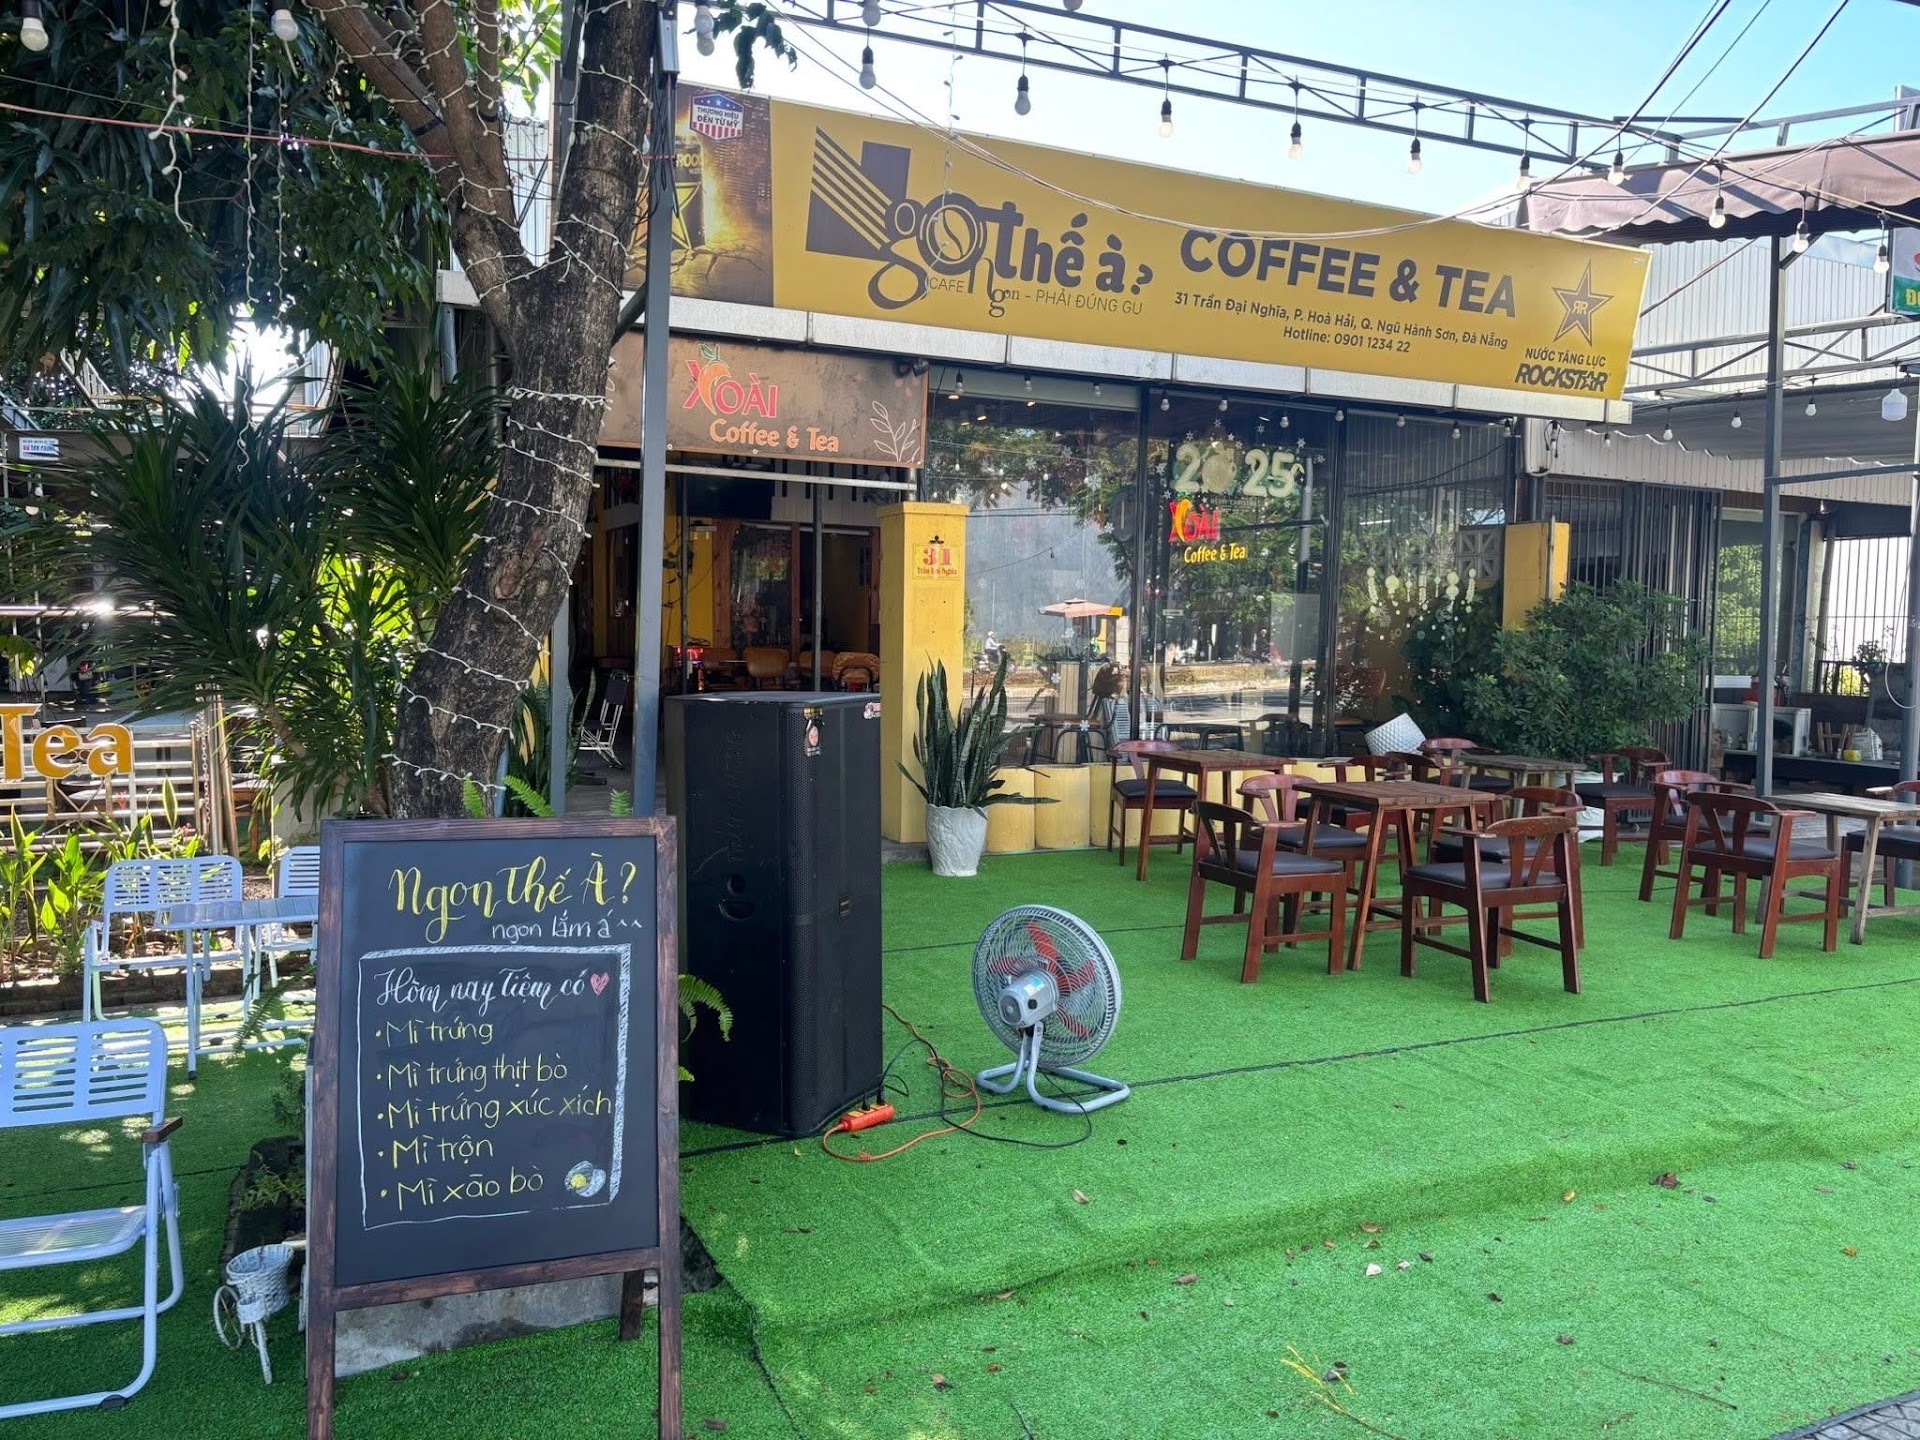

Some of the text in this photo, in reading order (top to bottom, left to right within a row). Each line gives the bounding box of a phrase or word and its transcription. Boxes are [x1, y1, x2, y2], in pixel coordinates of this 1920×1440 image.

[1180, 228, 1517, 318] COFFEE & TEA
[929, 276, 965, 293] CAFE
[1035, 288, 1070, 308] PHẢI
[1075, 292, 1117, 313] ĐÚNG
[1122, 301, 1143, 315] GU
[1174, 292, 1188, 305] 31
[1193, 293, 1221, 310] Trần
[1225, 299, 1246, 315] Đại
[1250, 302, 1289, 320] Nghĩa,
[1294, 308, 1304, 321] P.
[1335, 314, 1357, 330] Hải,
[1361, 317, 1373, 330] Q.
[1377, 320, 1400, 335] Ngũ
[1404, 324, 1432, 338] Hành
[1435, 328, 1458, 343] Sơn,
[1462, 331, 1476, 344] Đà
[1480, 332, 1508, 350] Nẵng
[1283, 326, 1411, 353] Hotline: 0901 1234 22
[1514, 363, 1608, 392] ROCKSTAR
[1525, 347, 1606, 369] NƯỚC TĂNG LỰC
[709, 418, 839, 452] Coffee & Tea
[1184, 542, 1246, 563] Coffee & Tea
[0, 703, 134, 781] Tea
[388, 866, 501, 944] Ngon
[496, 855, 572, 913] Thế
[492, 922, 541, 944] ngon
[552, 909, 591, 938] lắm
[450, 977, 497, 1017] nay
[560, 968, 590, 997] có
[386, 1015, 494, 1048] Mì trứng
[388, 1052, 567, 1092] Mì trứng thịt bò
[388, 1085, 612, 1129] Mì trứng xúc xích
[393, 1134, 493, 1169] Mì trộn
[398, 1178, 438, 1211] Mì
[510, 1166, 543, 1193] bò
